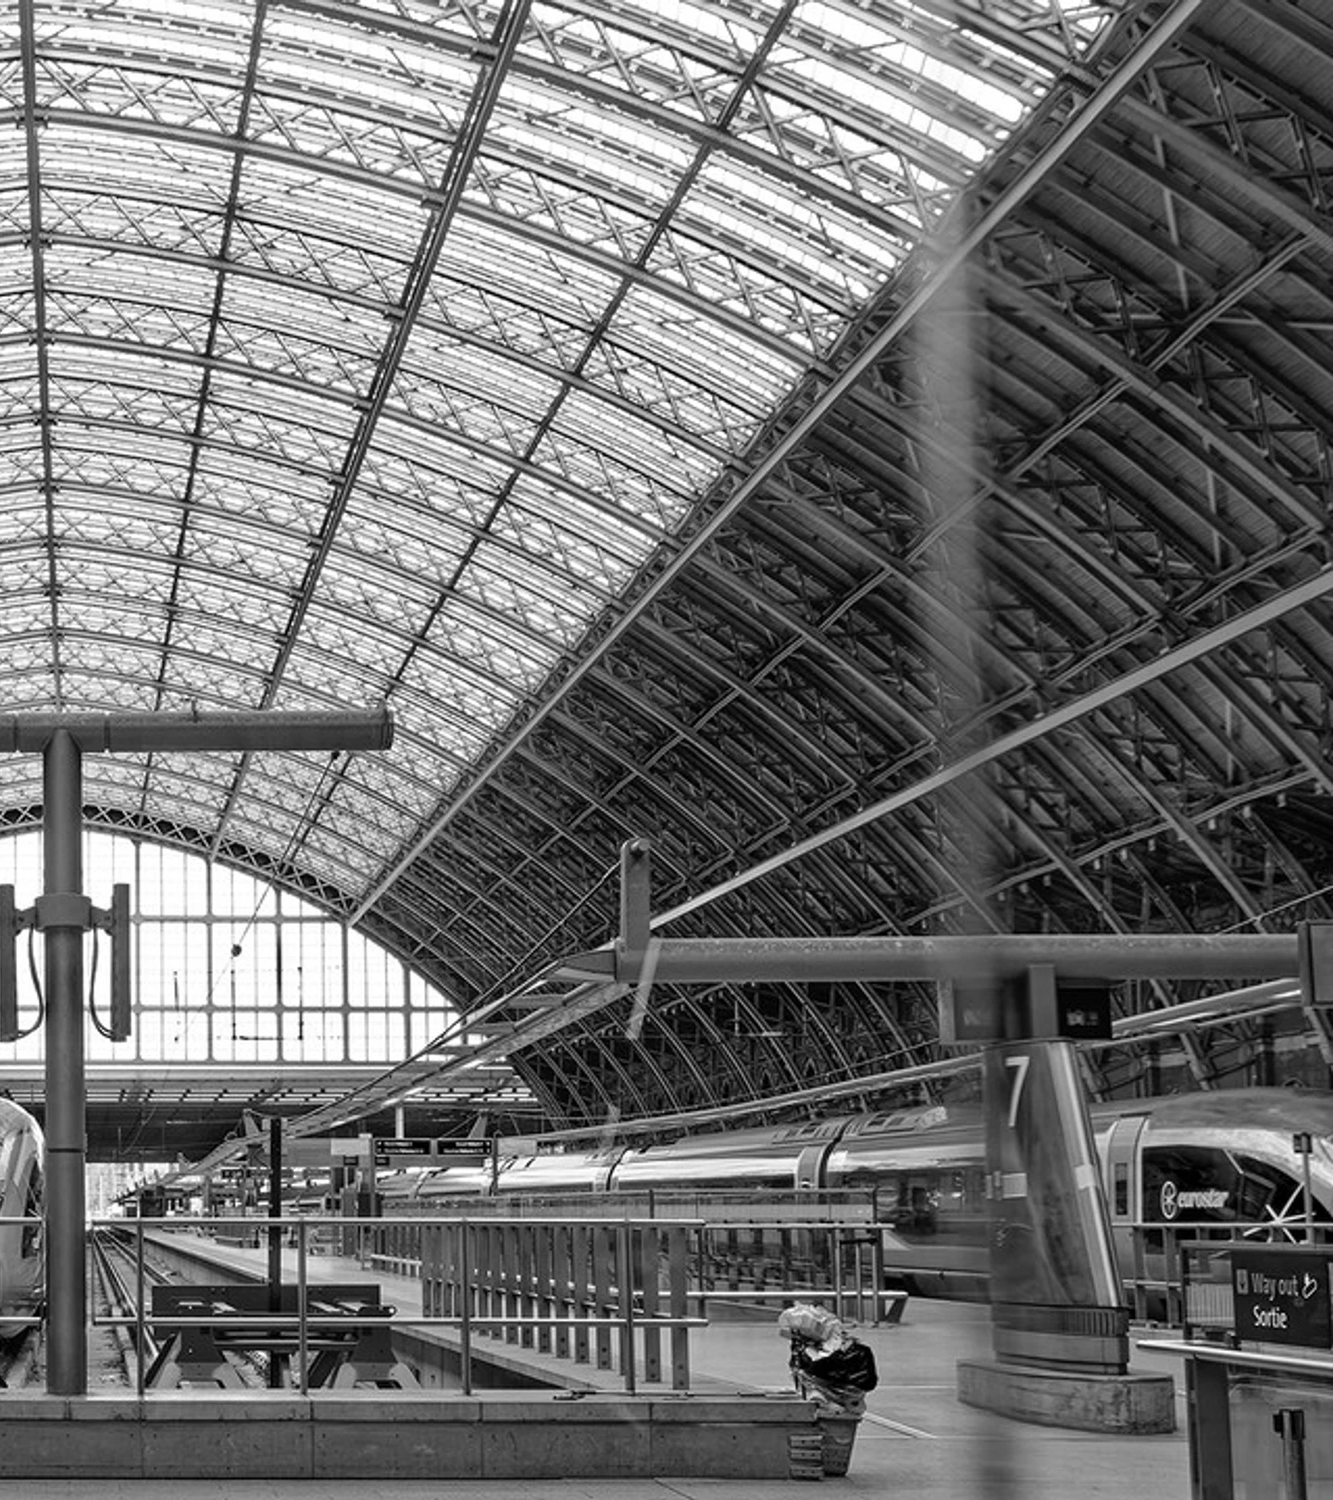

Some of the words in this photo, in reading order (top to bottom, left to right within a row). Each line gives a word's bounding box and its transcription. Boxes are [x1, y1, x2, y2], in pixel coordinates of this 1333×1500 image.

[1005, 1055, 1030, 1127] 7
[1177, 1188, 1229, 1209] eurostar
[1251, 1272, 1277, 1301] Way
[1278, 1275, 1299, 1297] out
[1253, 1305, 1288, 1330] Sortie
